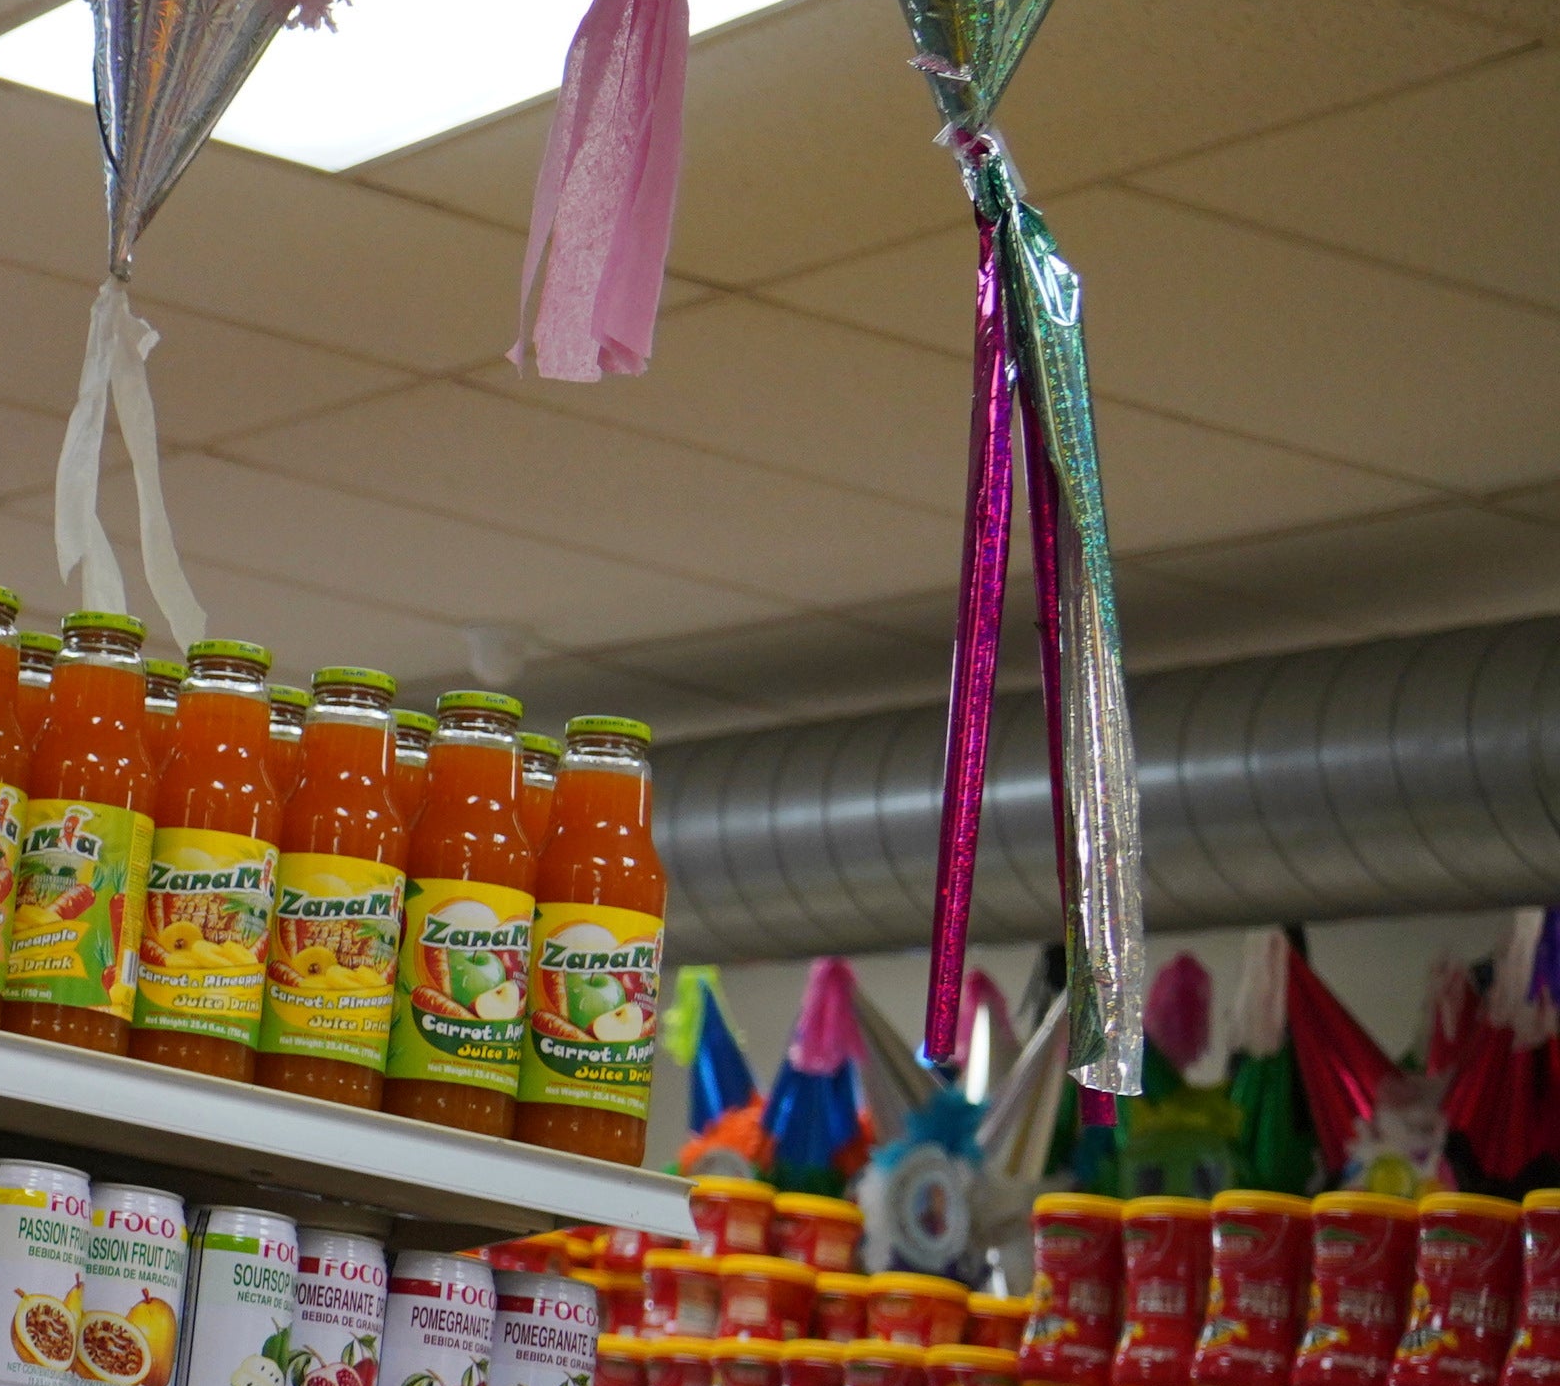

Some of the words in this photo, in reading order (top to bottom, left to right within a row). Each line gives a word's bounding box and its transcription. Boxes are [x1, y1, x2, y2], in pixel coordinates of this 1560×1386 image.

[24, 954, 73, 972] Drink
[139, 969, 189, 988] Carrot
[174, 992, 224, 1011] Juice
[270, 986, 325, 1009] Carrot
[308, 1014, 356, 1032] Juice
[423, 1014, 492, 1041] Carrot
[457, 1044, 504, 1062] Juice
[540, 1037, 613, 1064] Carrot
[574, 1065, 624, 1084] Juice
[109, 1209, 175, 1240] FOCO
[504, 1321, 589, 1355] POMEGRANATE
